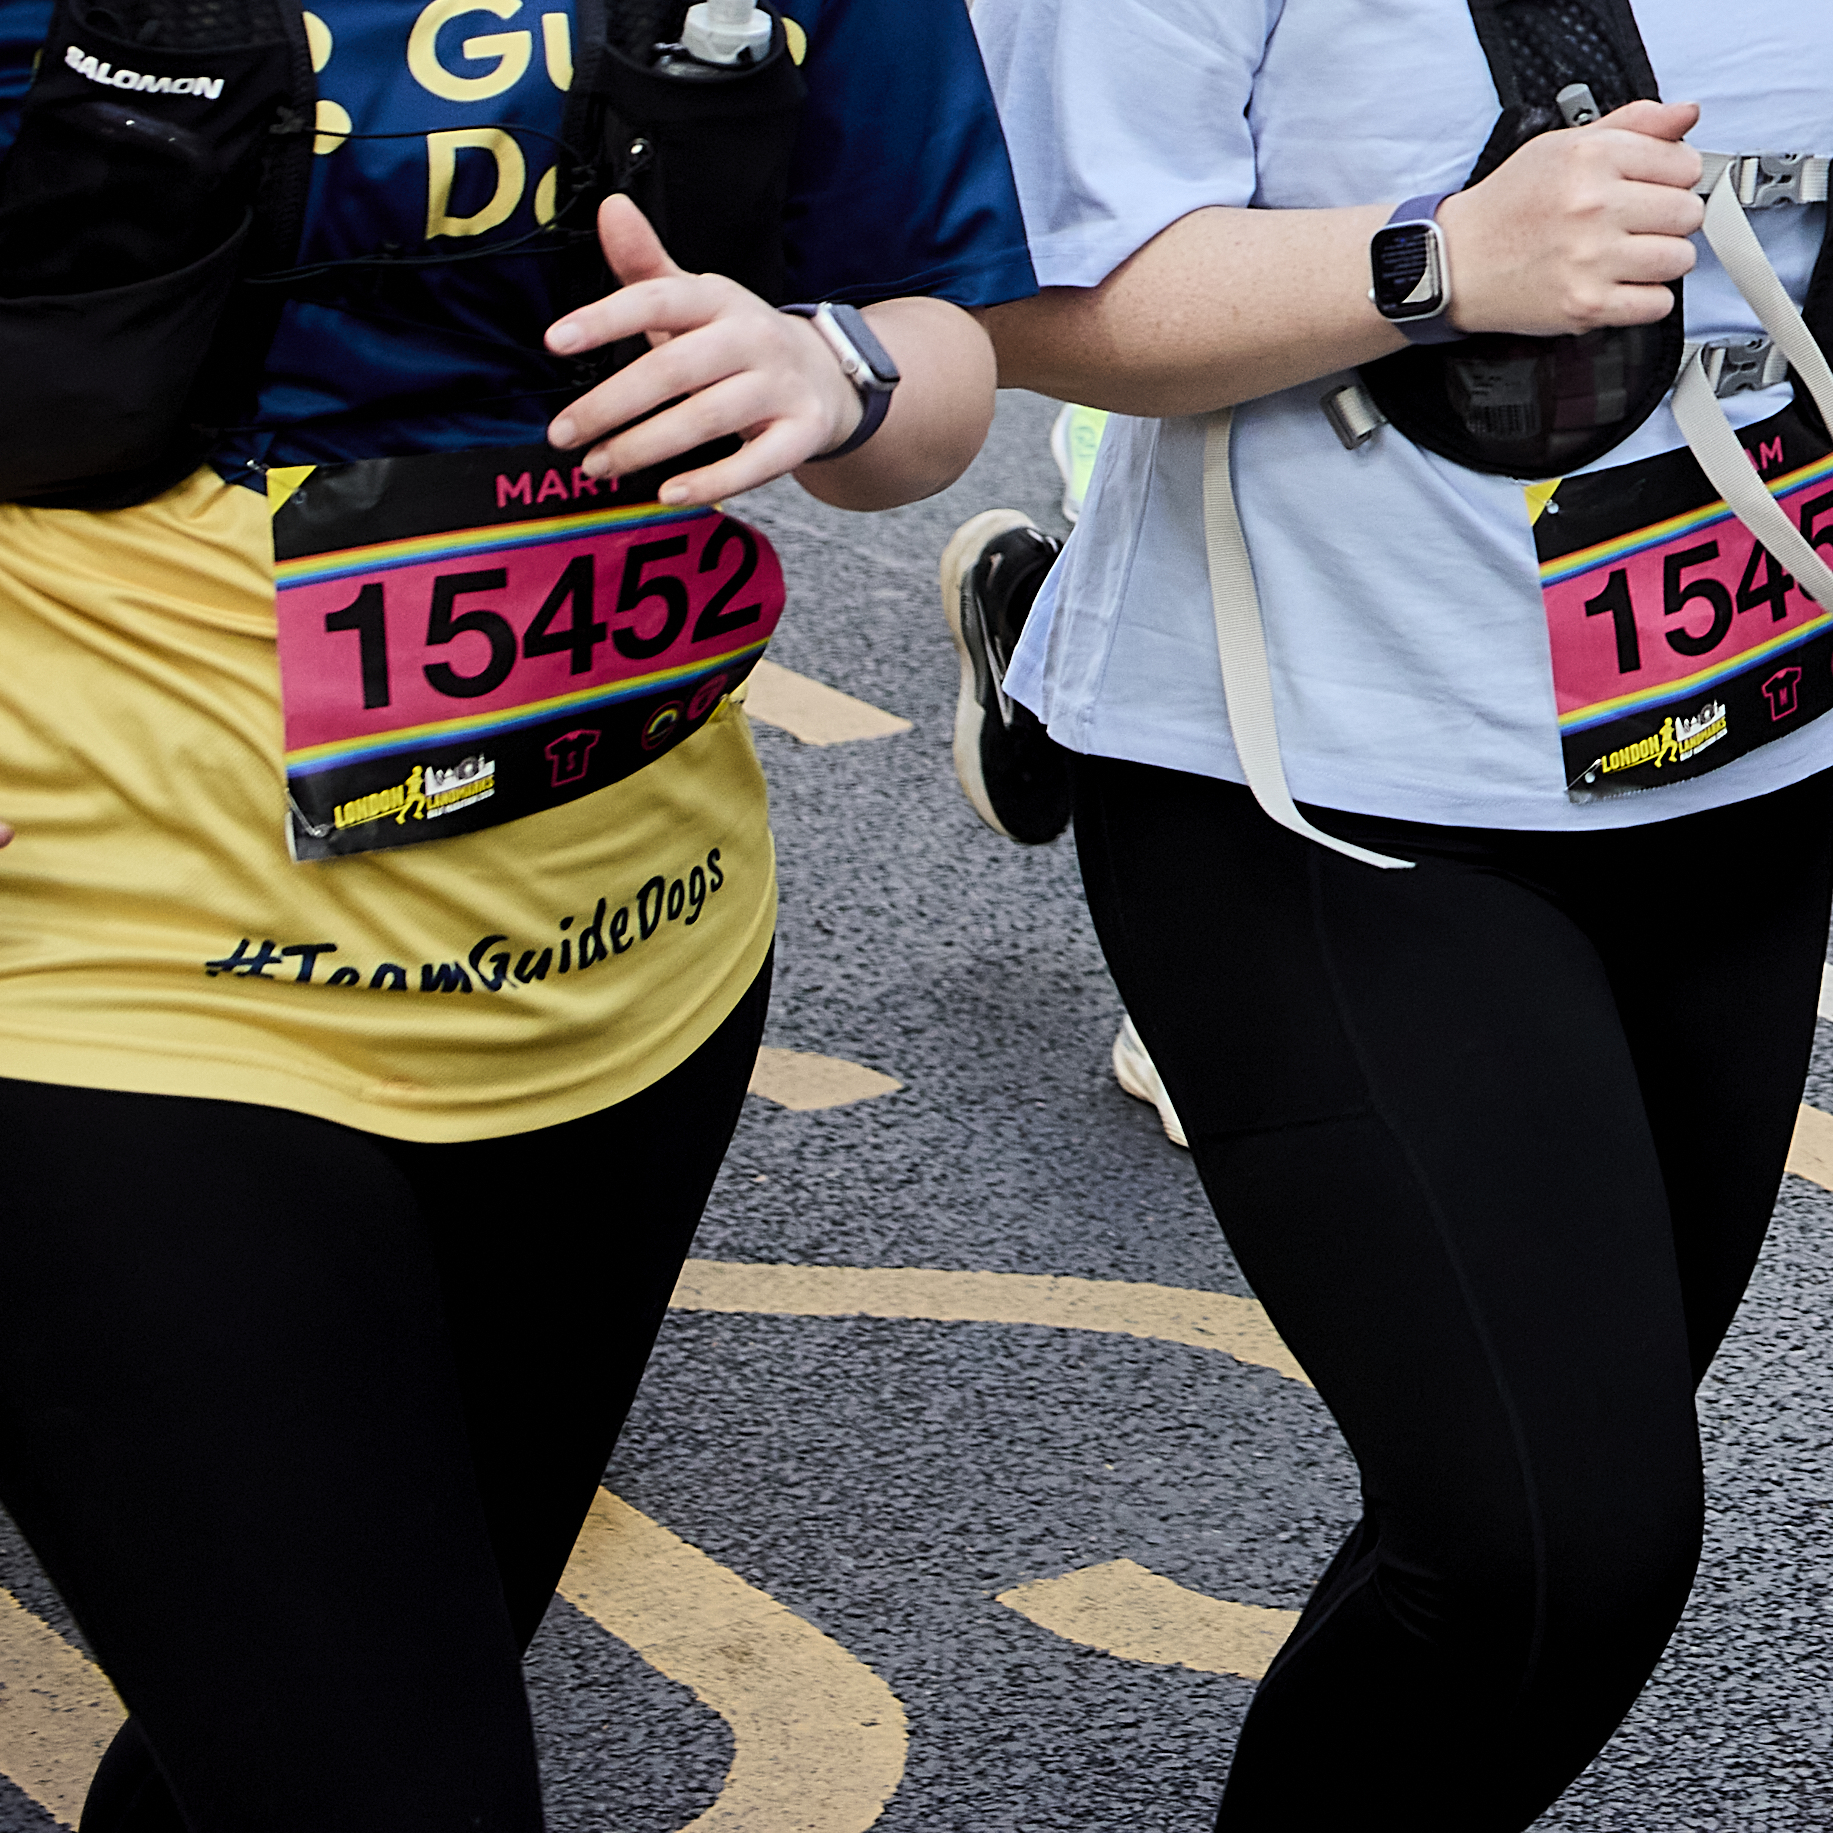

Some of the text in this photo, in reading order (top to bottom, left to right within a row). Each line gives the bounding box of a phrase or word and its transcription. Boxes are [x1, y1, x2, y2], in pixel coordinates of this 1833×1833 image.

[65, 45, 225, 100] SALOMON
[324, 516, 762, 710] 15452
[1602, 733, 1661, 774] LONDON
[205, 847, 725, 994] #TeamGuideDogs
